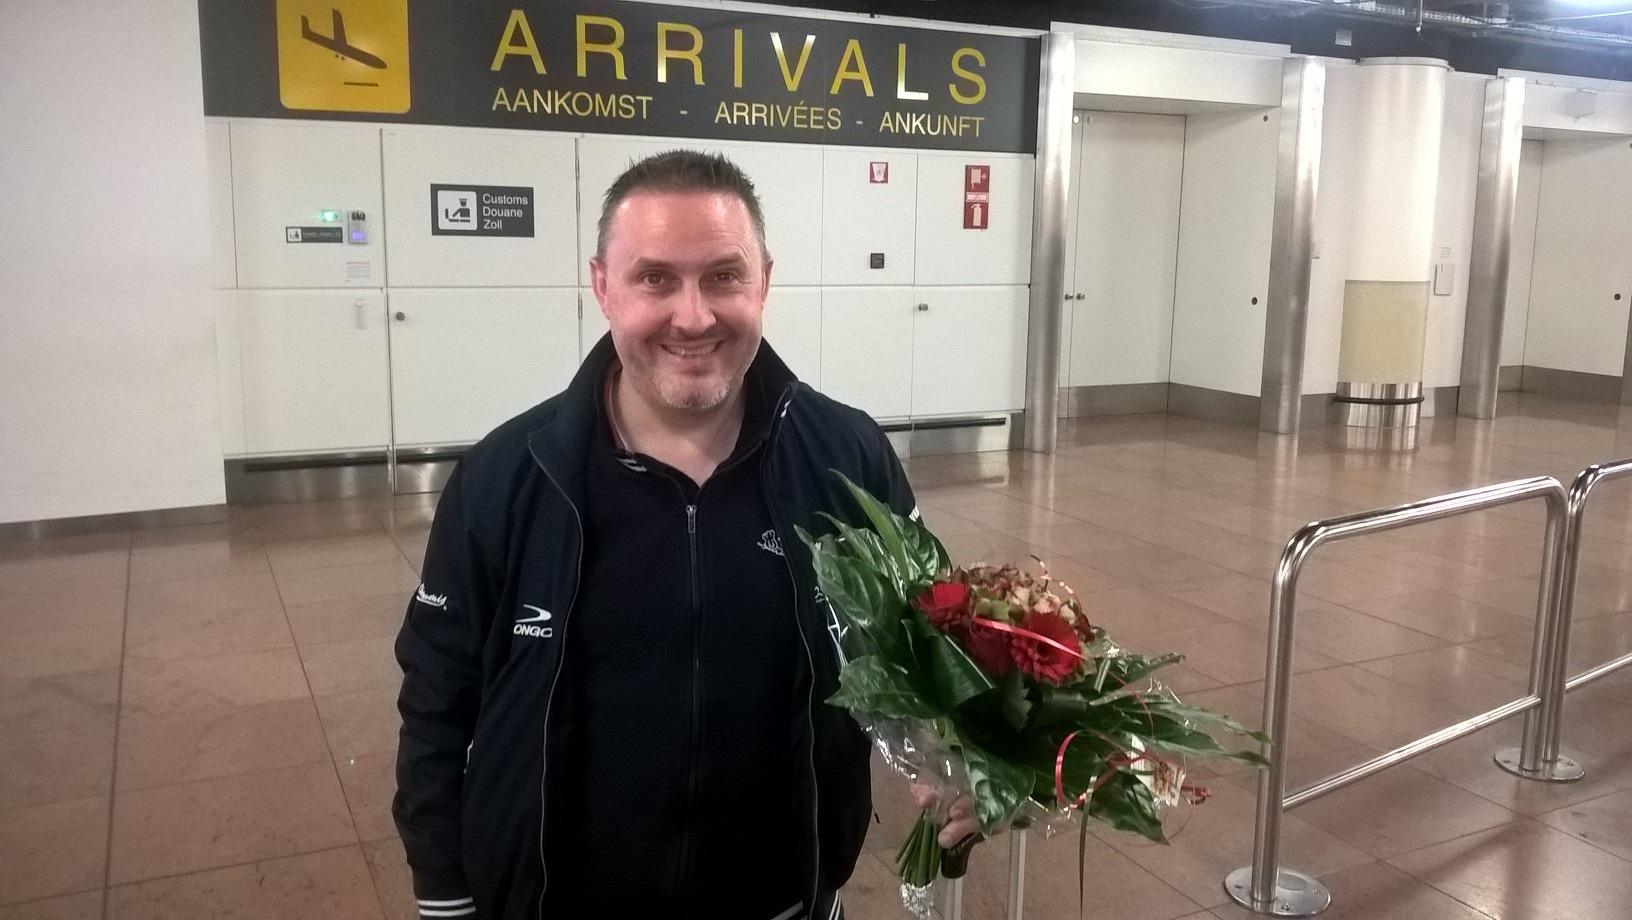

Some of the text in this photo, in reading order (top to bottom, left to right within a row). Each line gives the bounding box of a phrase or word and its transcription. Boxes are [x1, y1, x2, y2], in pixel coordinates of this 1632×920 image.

[490, 9, 987, 105] ARRIVALS
[491, 86, 654, 119] AANKOMST
[714, 100, 842, 130] ARRIVÉES
[879, 110, 985, 138] ANKUNFT
[482, 193, 529, 206] Customs
[482, 206, 523, 218] Douane
[483, 218, 503, 230] Zoll
